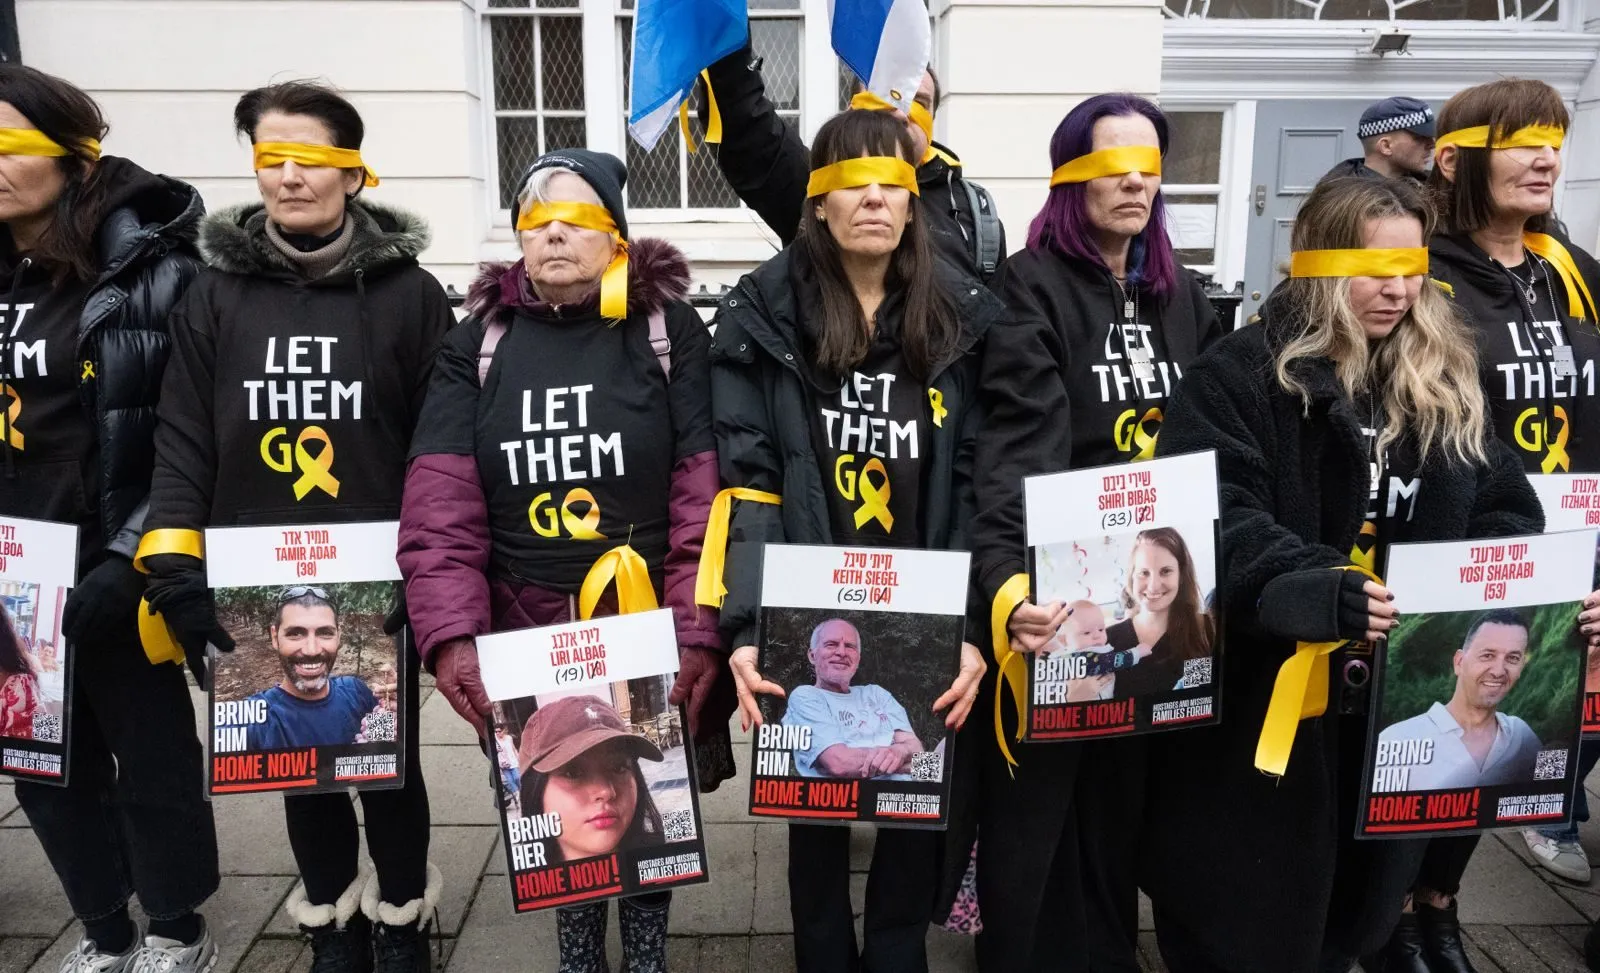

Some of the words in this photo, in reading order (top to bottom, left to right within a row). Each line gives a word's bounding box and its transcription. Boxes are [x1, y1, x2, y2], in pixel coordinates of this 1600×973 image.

[265, 336, 338, 374] LET
[243, 380, 362, 420] THEM
[839, 371, 896, 414] LET
[521, 384, 594, 433] LET
[821, 408, 919, 459] THEM
[500, 432, 625, 486] THEM
[1102, 474, 1126, 492] ביבס
[1128, 470, 1151, 488] שירי
[1098, 492, 1125, 511] SHIRI
[1127, 487, 1157, 507] BIBAS
[1561, 495, 1590, 509] ITZHAK
[1101, 510, 1132, 530] (33)
[1585, 510, 1600, 526] (68
[0, 524, 16, 541] דני
[282, 531, 302, 545] אדר
[304, 530, 329, 544] תמיר
[275, 547, 307, 561] TAMIR
[309, 546, 337, 560] ADAR
[843, 551, 867, 568] סיגל
[1470, 546, 1505, 564] שרעבי
[1508, 543, 1528, 561] יוסי
[296, 561, 317, 577] (38)
[833, 569, 863, 585] KEITH
[865, 570, 899, 587] SIEGEL
[1460, 565, 1484, 583] YOSI
[1487, 561, 1534, 581] SHARABI
[837, 587, 867, 604] (65)
[1484, 581, 1506, 602] (53)
[551, 632, 578, 649] אלבג
[579, 627, 599, 644] לירי
[550, 650, 571, 667] LIRI
[573, 644, 606, 663] ALBAG
[555, 665, 584, 685] (19)
[1034, 656, 1087, 681] BRING
[1033, 681, 1067, 705] HER
[215, 700, 267, 726] BRING
[1033, 706, 1082, 730] HOME
[1086, 697, 1135, 726] NOW!
[1153, 703, 1179, 711] HOSTAGES
[1179, 699, 1190, 708] AND
[1153, 708, 1185, 722] FAMILIES
[1186, 703, 1213, 717] FORUM
[214, 726, 248, 753] HIM
[758, 724, 812, 751] BRING
[3, 747, 28, 759] HOSTAGES
[29, 751, 39, 760] AND
[335, 756, 362, 765] HOSTAGES
[361, 755, 373, 764] AND
[1375, 738, 1434, 766] BRING
[3, 756, 35, 770] FAMILIES
[36, 760, 61, 775] FORUM
[214, 754, 262, 782] HOME
[267, 747, 318, 778] NOW!
[335, 764, 368, 778] FAMILIES
[369, 763, 397, 775] FORUM
[756, 750, 790, 776] HIM
[1372, 766, 1410, 793] HIM
[754, 779, 804, 806] HOME
[807, 780, 859, 808] NOW!
[877, 792, 904, 802] HOSTAGES
[905, 793, 916, 802] AND
[1498, 796, 1527, 806] HOSTAGES
[1527, 794, 1539, 804] AND
[877, 800, 911, 814] FAMILIES
[911, 802, 940, 815] FORUM
[1369, 796, 1423, 822] HOME
[1426, 788, 1480, 820] NOW!
[1497, 804, 1533, 818] FAMILIES
[1534, 801, 1564, 815] FORUM
[507, 811, 562, 844] BRING
[512, 841, 547, 871] HER
[637, 857, 665, 870] HOSTAGES
[665, 855, 676, 865] AND
[516, 867, 567, 900] HOME
[569, 854, 620, 890] NOW!
[639, 865, 673, 882] FAMILIES
[673, 861, 702, 876] FORUM
